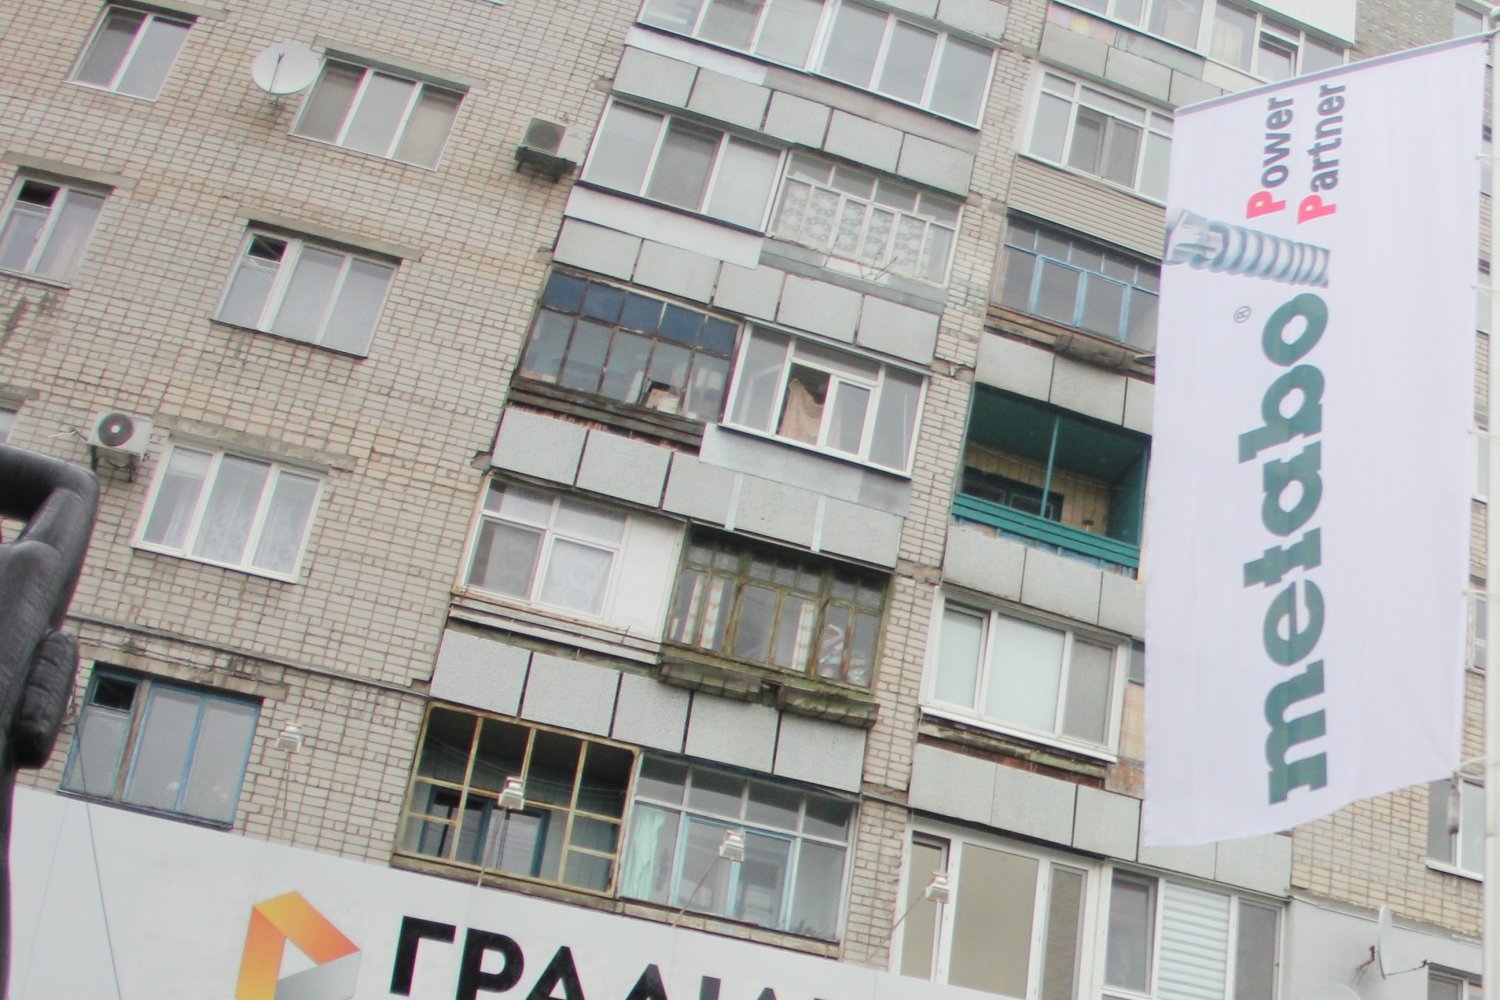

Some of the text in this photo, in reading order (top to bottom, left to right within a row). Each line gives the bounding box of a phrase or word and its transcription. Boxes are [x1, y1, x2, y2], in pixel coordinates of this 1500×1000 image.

[1246, 96, 1294, 219] Power
[1297, 83, 1347, 224] Partner
[1238, 292, 1328, 806] metabo
